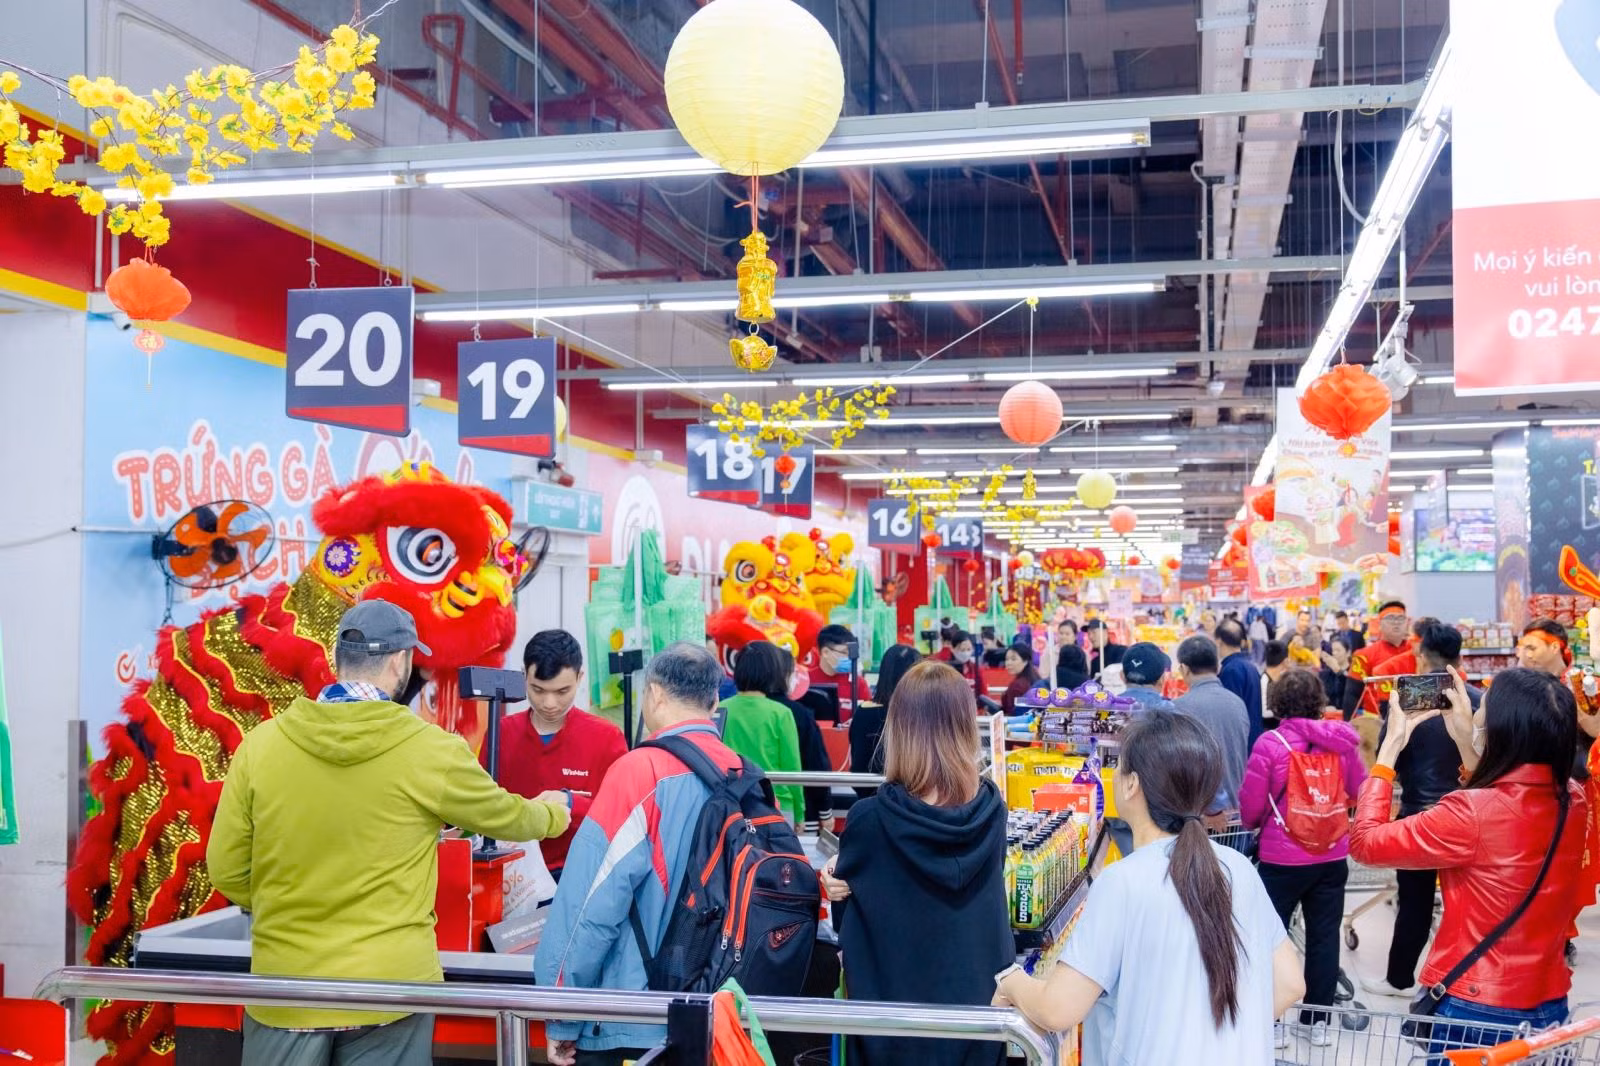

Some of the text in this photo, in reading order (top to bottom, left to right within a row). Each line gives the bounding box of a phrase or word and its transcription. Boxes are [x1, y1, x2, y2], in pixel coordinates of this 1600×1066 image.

[1474, 244, 1592, 274] Mọi ý kiến
[1524, 277, 1558, 297] vui
[1508, 306, 1600, 340] 0247
[294, 311, 403, 387] 20
[466, 358, 545, 421] 19
[117, 425, 274, 519] TRỨNG
[282, 424, 337, 502] GÀ
[694, 437, 754, 480] 18
[872, 508, 913, 537] 16
[936, 523, 970, 547] 14
